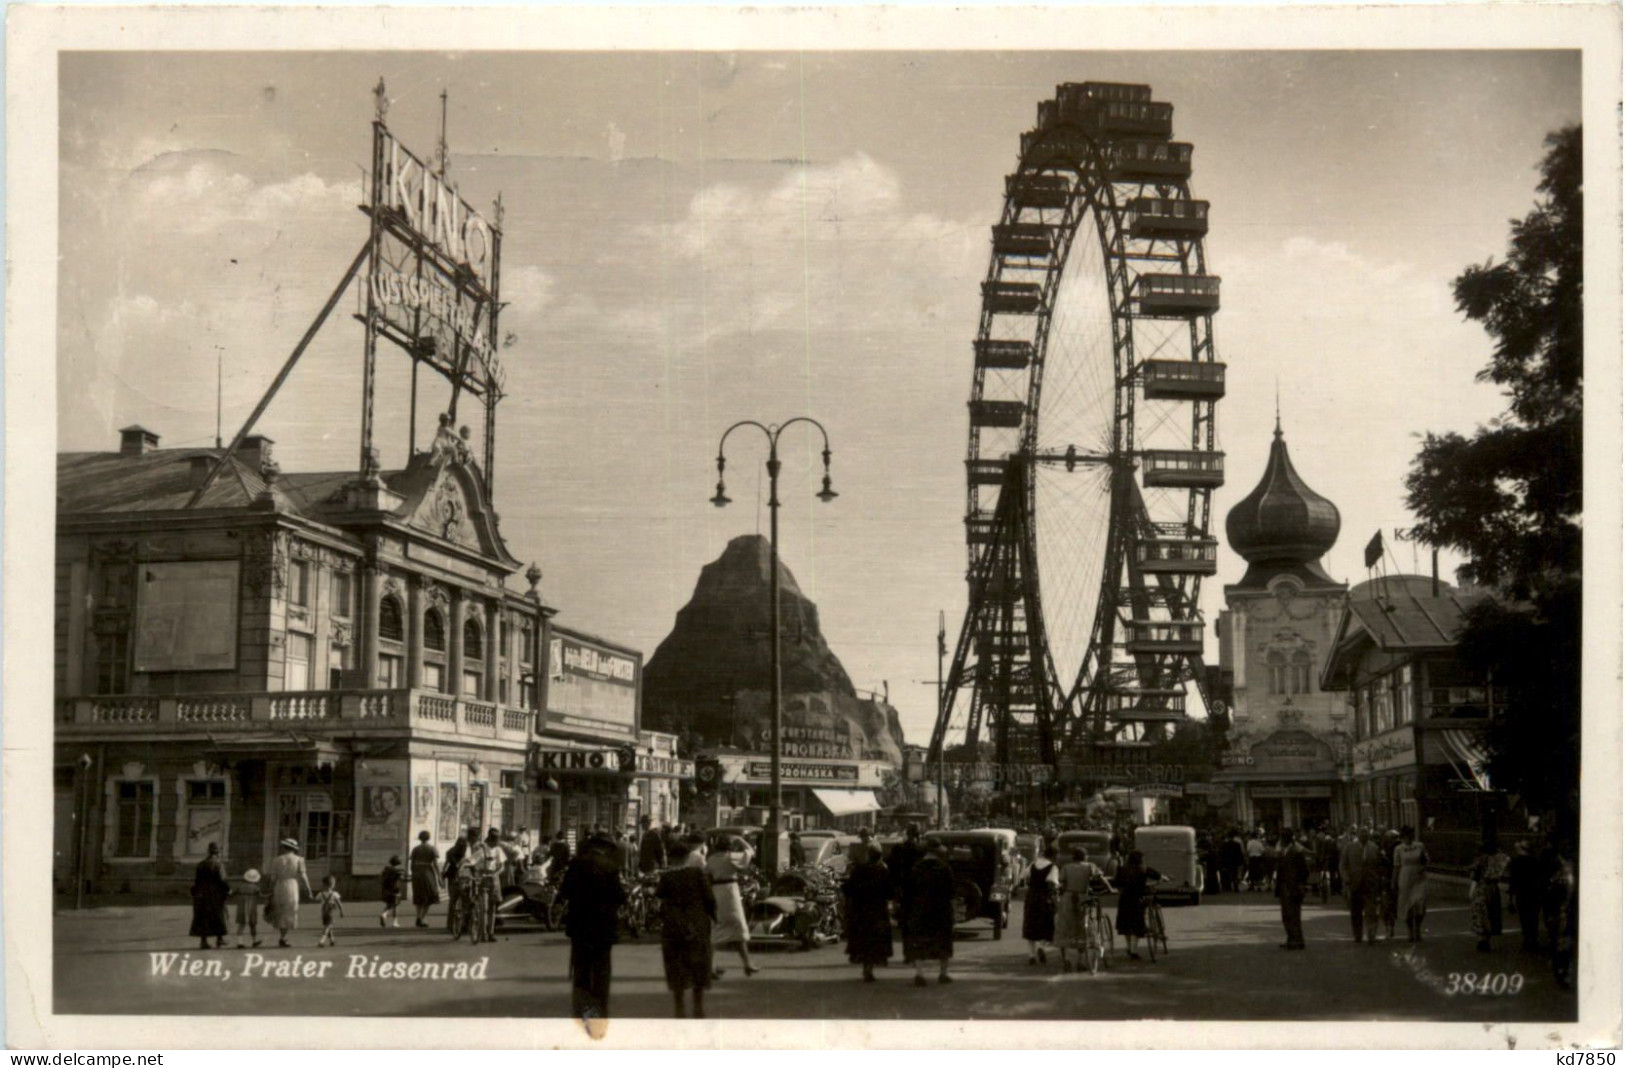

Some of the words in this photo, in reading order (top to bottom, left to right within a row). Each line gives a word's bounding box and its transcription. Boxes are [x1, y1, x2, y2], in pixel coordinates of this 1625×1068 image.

[390, 136, 490, 270] KINO
[785, 742, 850, 759] PROHASKA
[543, 751, 604, 769] KINO
